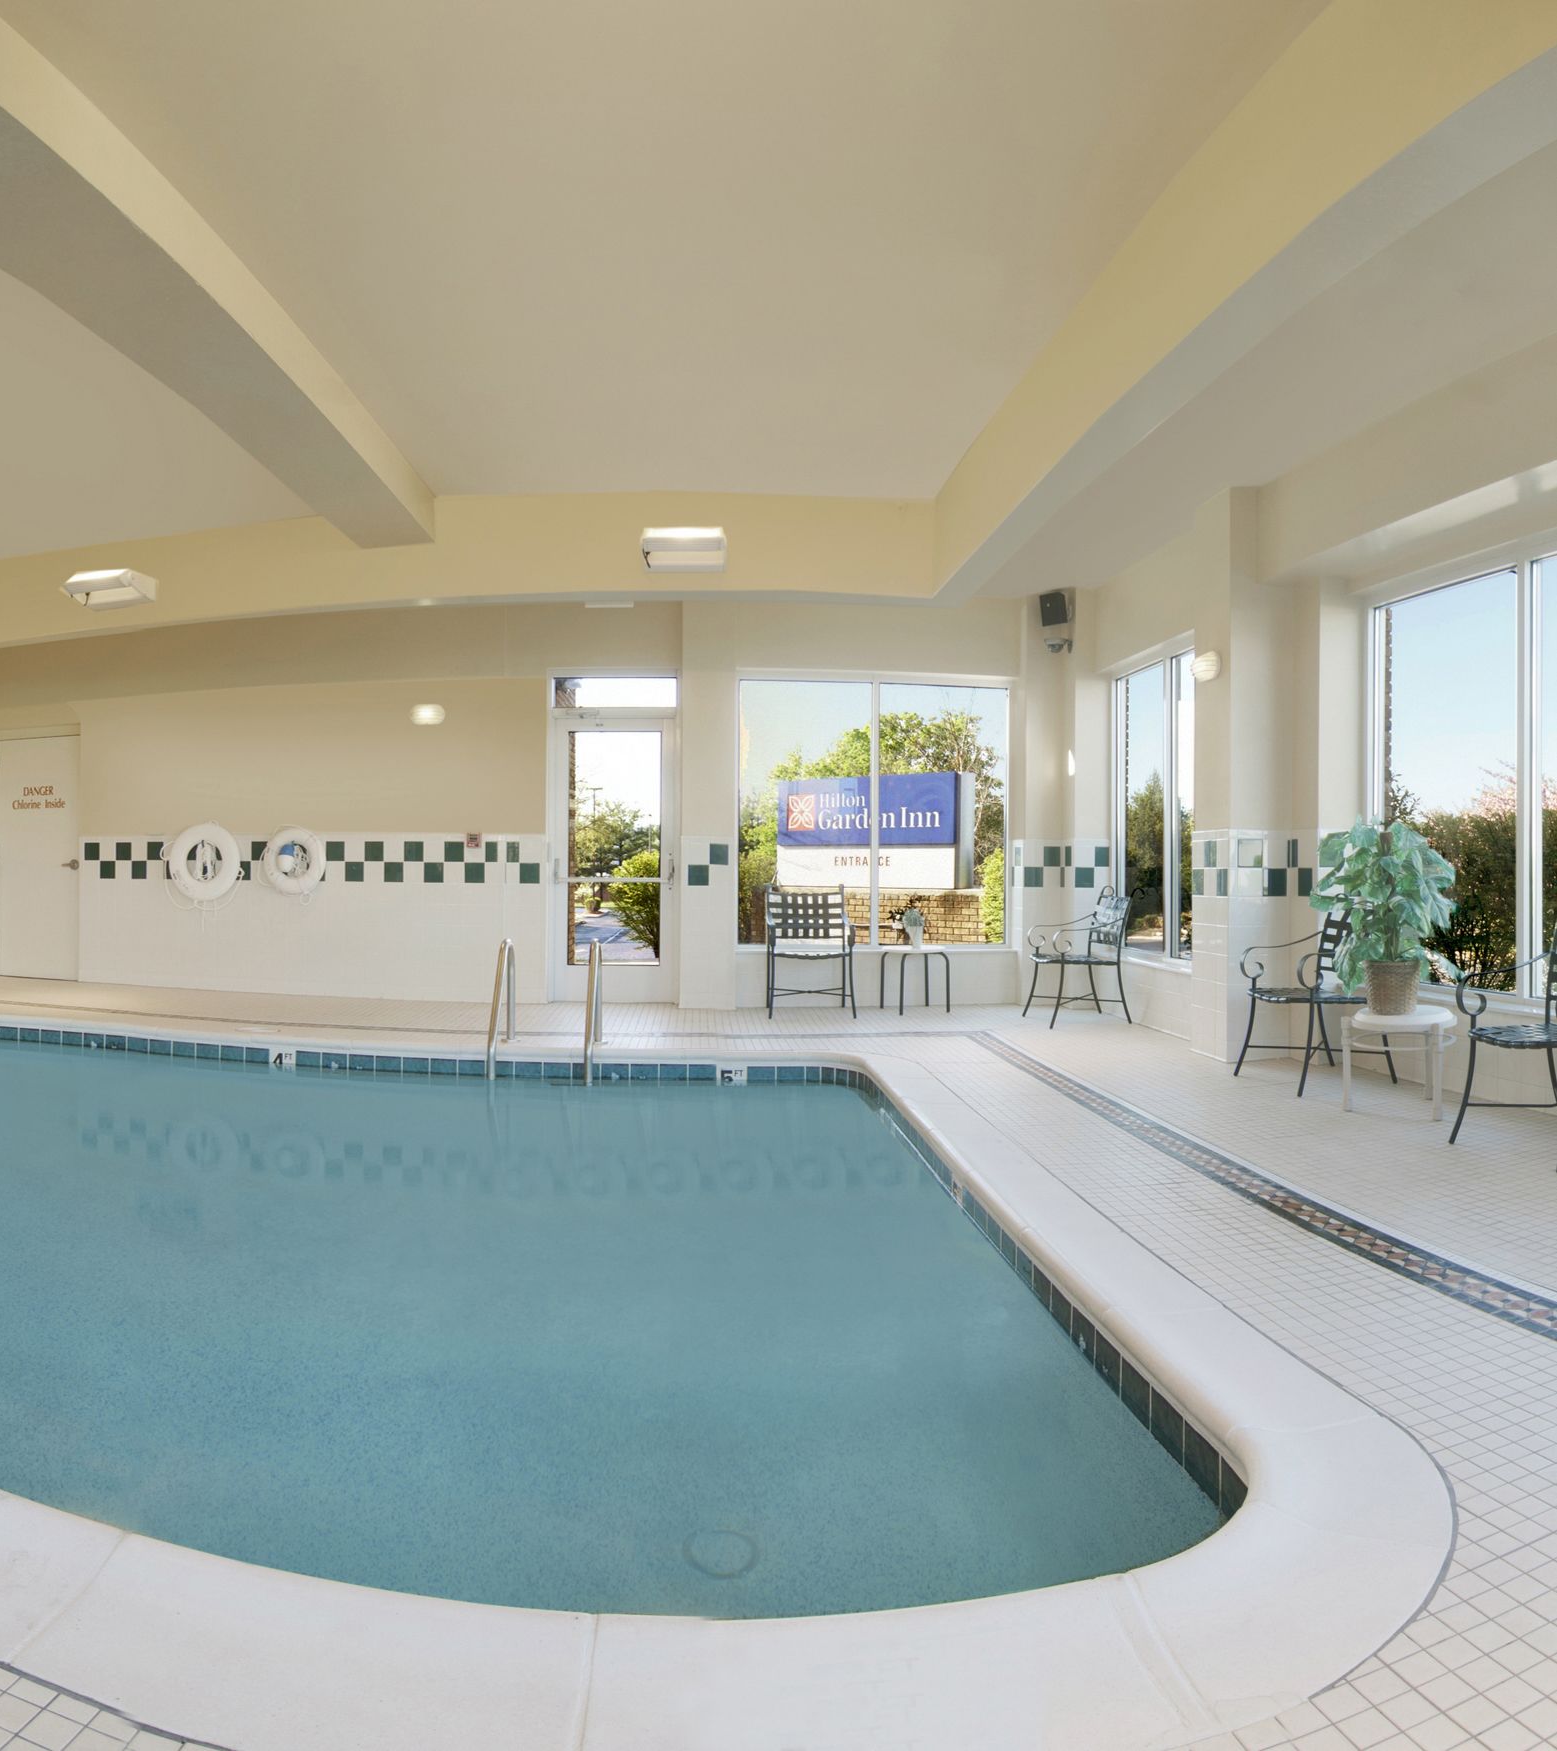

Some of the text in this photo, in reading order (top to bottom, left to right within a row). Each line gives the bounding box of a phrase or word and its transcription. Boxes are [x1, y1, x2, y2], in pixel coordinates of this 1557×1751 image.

[23, 785, 54, 796] DANGER
[12, 798, 66, 810] Chlorine Inside
[819, 793, 866, 808] Hilton
[818, 806, 941, 831] Gardn Inn
[834, 856, 891, 867] ENTRACE
[734, 1069, 743, 1077] FT
